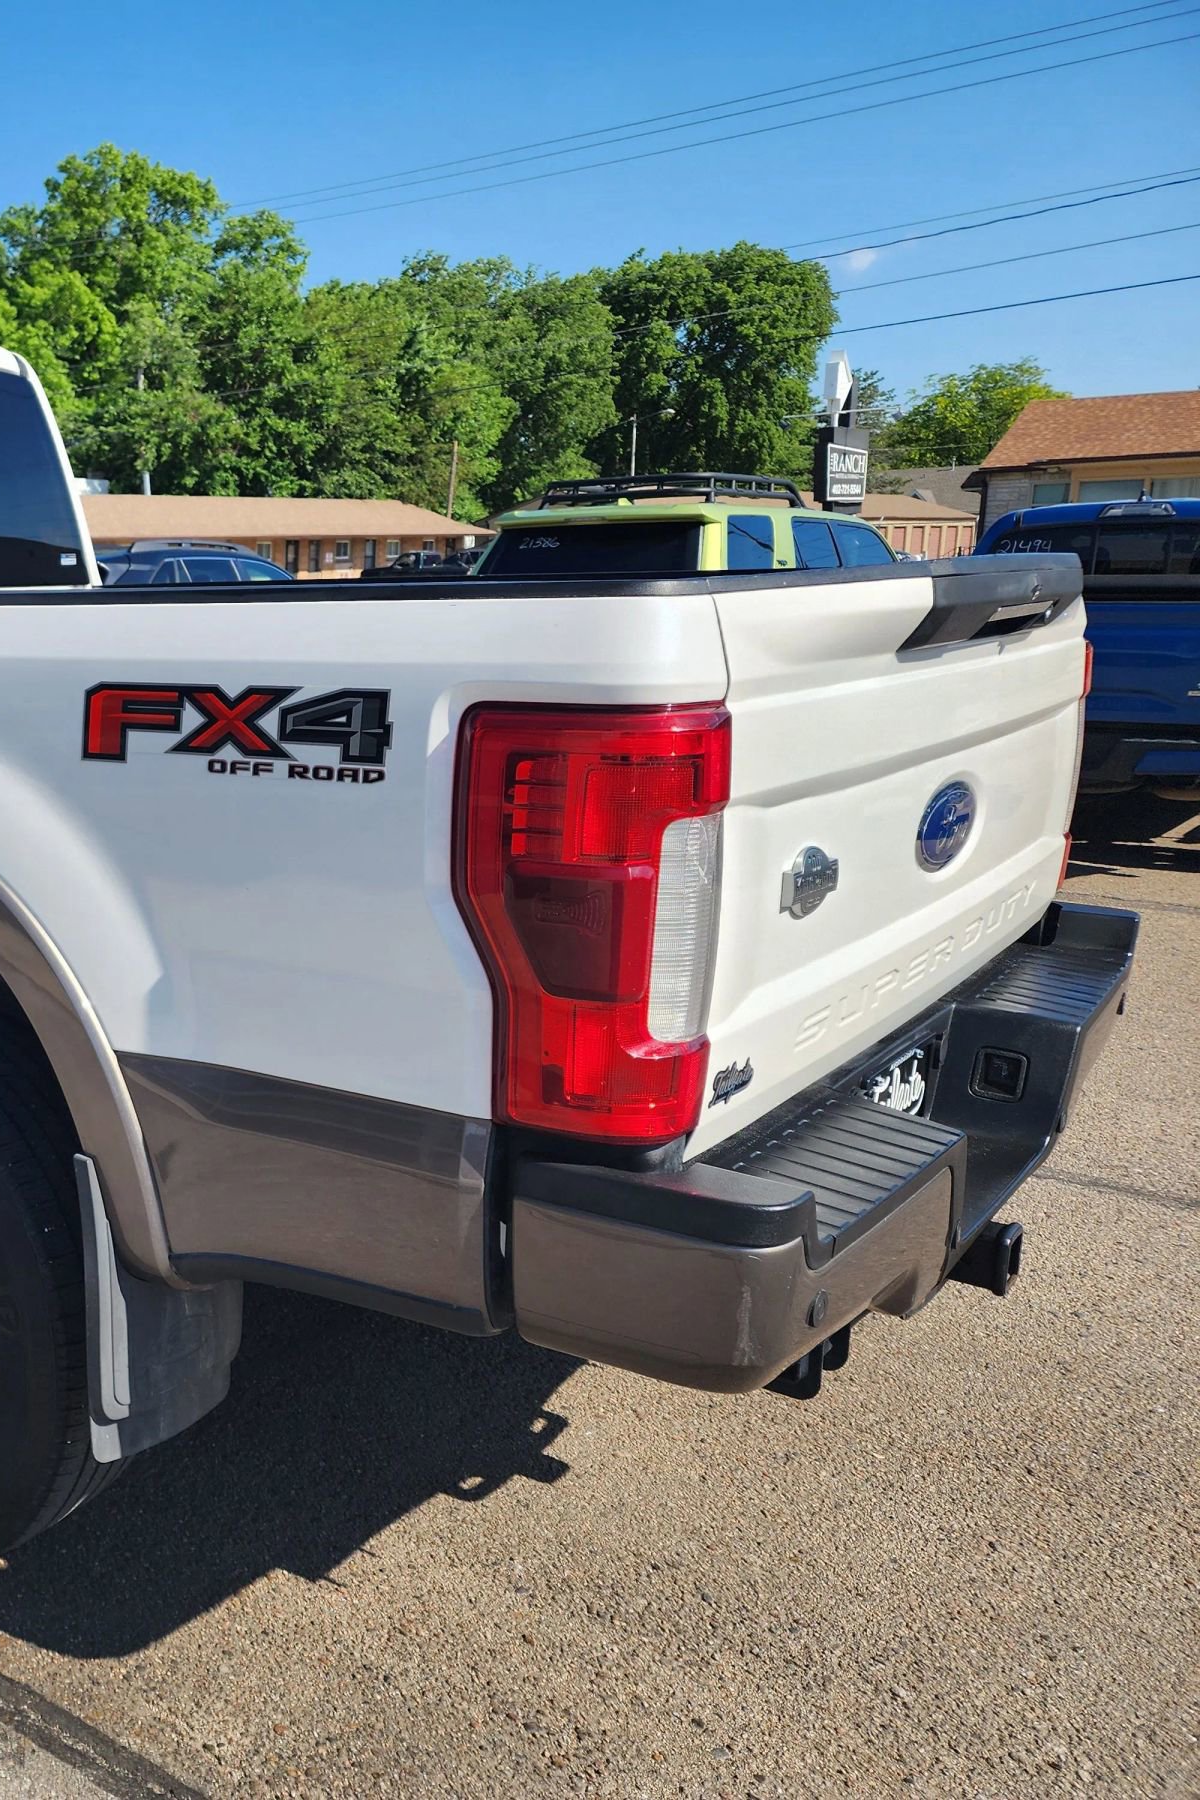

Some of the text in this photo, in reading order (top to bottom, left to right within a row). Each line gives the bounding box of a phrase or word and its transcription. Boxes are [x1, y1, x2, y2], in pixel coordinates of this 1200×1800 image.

[832, 452, 866, 474] RANCH
[997, 539, 1052, 554] 21494
[81, 678, 393, 767] FX4
[207, 758, 386, 784] OFF ROAD
[794, 879, 1038, 1053] SUPER DUTY
